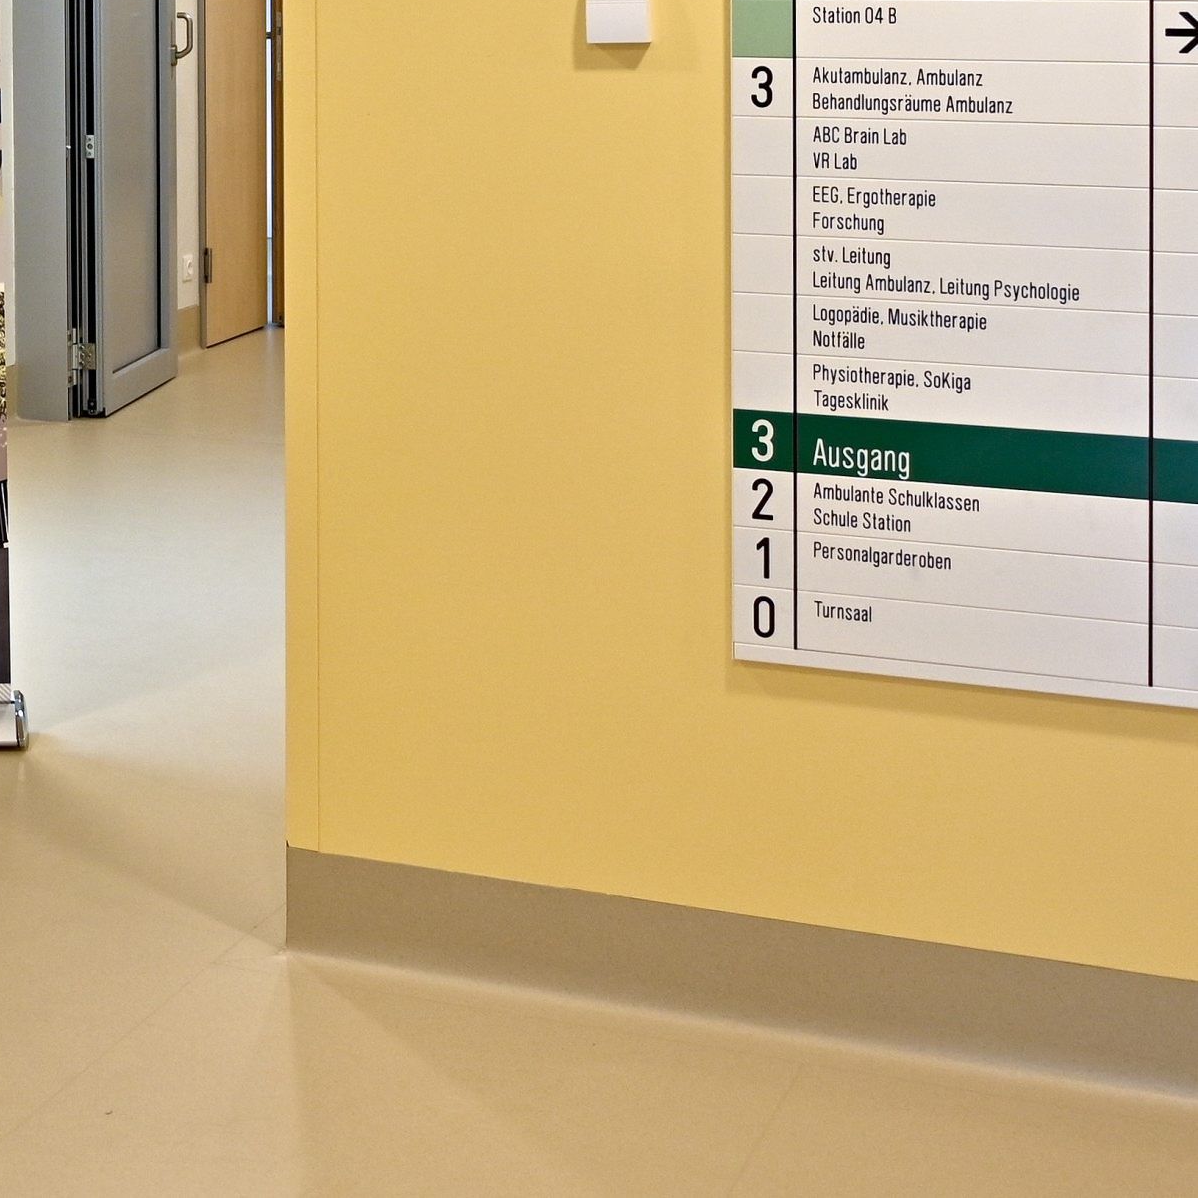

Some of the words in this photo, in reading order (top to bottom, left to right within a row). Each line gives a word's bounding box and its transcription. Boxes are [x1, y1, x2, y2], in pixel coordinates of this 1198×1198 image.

[812, 6, 861, 24] Station
[864, 6, 884, 25] 04
[888, 7, 897, 25] B
[750, 65, 774, 109] 3
[916, 68, 983, 87] Ambulanz
[812, 92, 941, 116] Behandlungsräume
[945, 95, 1013, 114] Ambulanz
[812, 125, 840, 144] ABC
[844, 126, 879, 145] Brain
[883, 127, 907, 146] Lab
[813, 151, 830, 169] VR
[834, 152, 858, 171] Lab
[847, 186, 936, 210] Ergotherapie
[812, 211, 885, 236] Forschung
[813, 245, 839, 263] stv.
[842, 246, 891, 270] Leitung
[812, 270, 861, 294] Leitung
[939, 277, 990, 301] Leitung
[994, 279, 1080, 305] Psychologie
[888, 307, 987, 333] Musiktherapie
[813, 329, 865, 350] Notfälle
[923, 370, 971, 394] SoKiga
[813, 389, 889, 412] Tagesklinik
[751, 419, 774, 462] 3
[813, 438, 910, 480] Ausgang
[751, 477, 774, 521] 2
[813, 482, 884, 505] Ambulante
[888, 487, 980, 512] Schulklassen
[813, 507, 858, 529] Schule
[862, 511, 911, 533] Station
[756, 537, 770, 580] 1
[813, 541, 952, 570] Personalgarderoben
[753, 595, 776, 639] 0
[813, 600, 872, 623] Turnsaal
